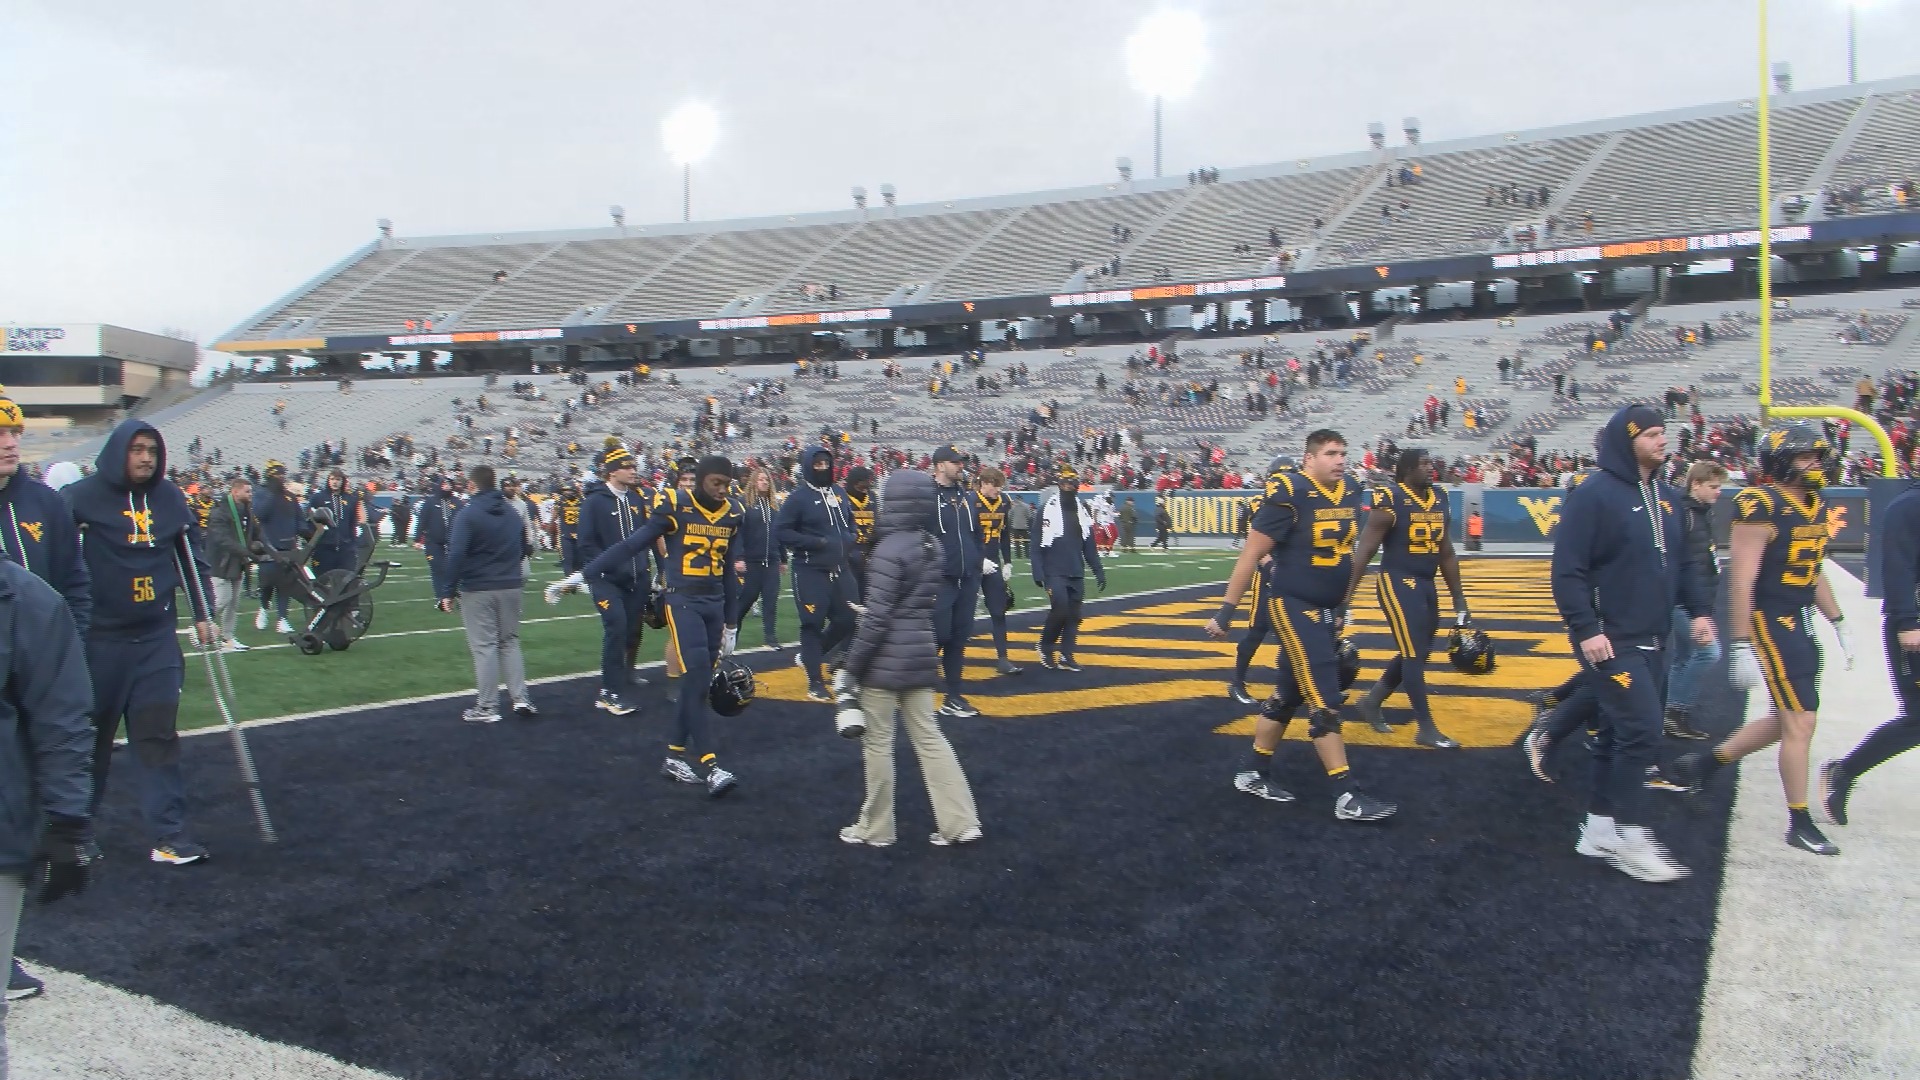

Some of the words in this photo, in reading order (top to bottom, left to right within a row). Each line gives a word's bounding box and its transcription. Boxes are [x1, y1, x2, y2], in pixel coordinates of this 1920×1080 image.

[8, 327, 65, 341] UNITED
[8, 340, 50, 353] BANK
[1311, 521, 1358, 568] 54
[1408, 523, 1445, 555] 97
[132, 576, 156, 603] 56
